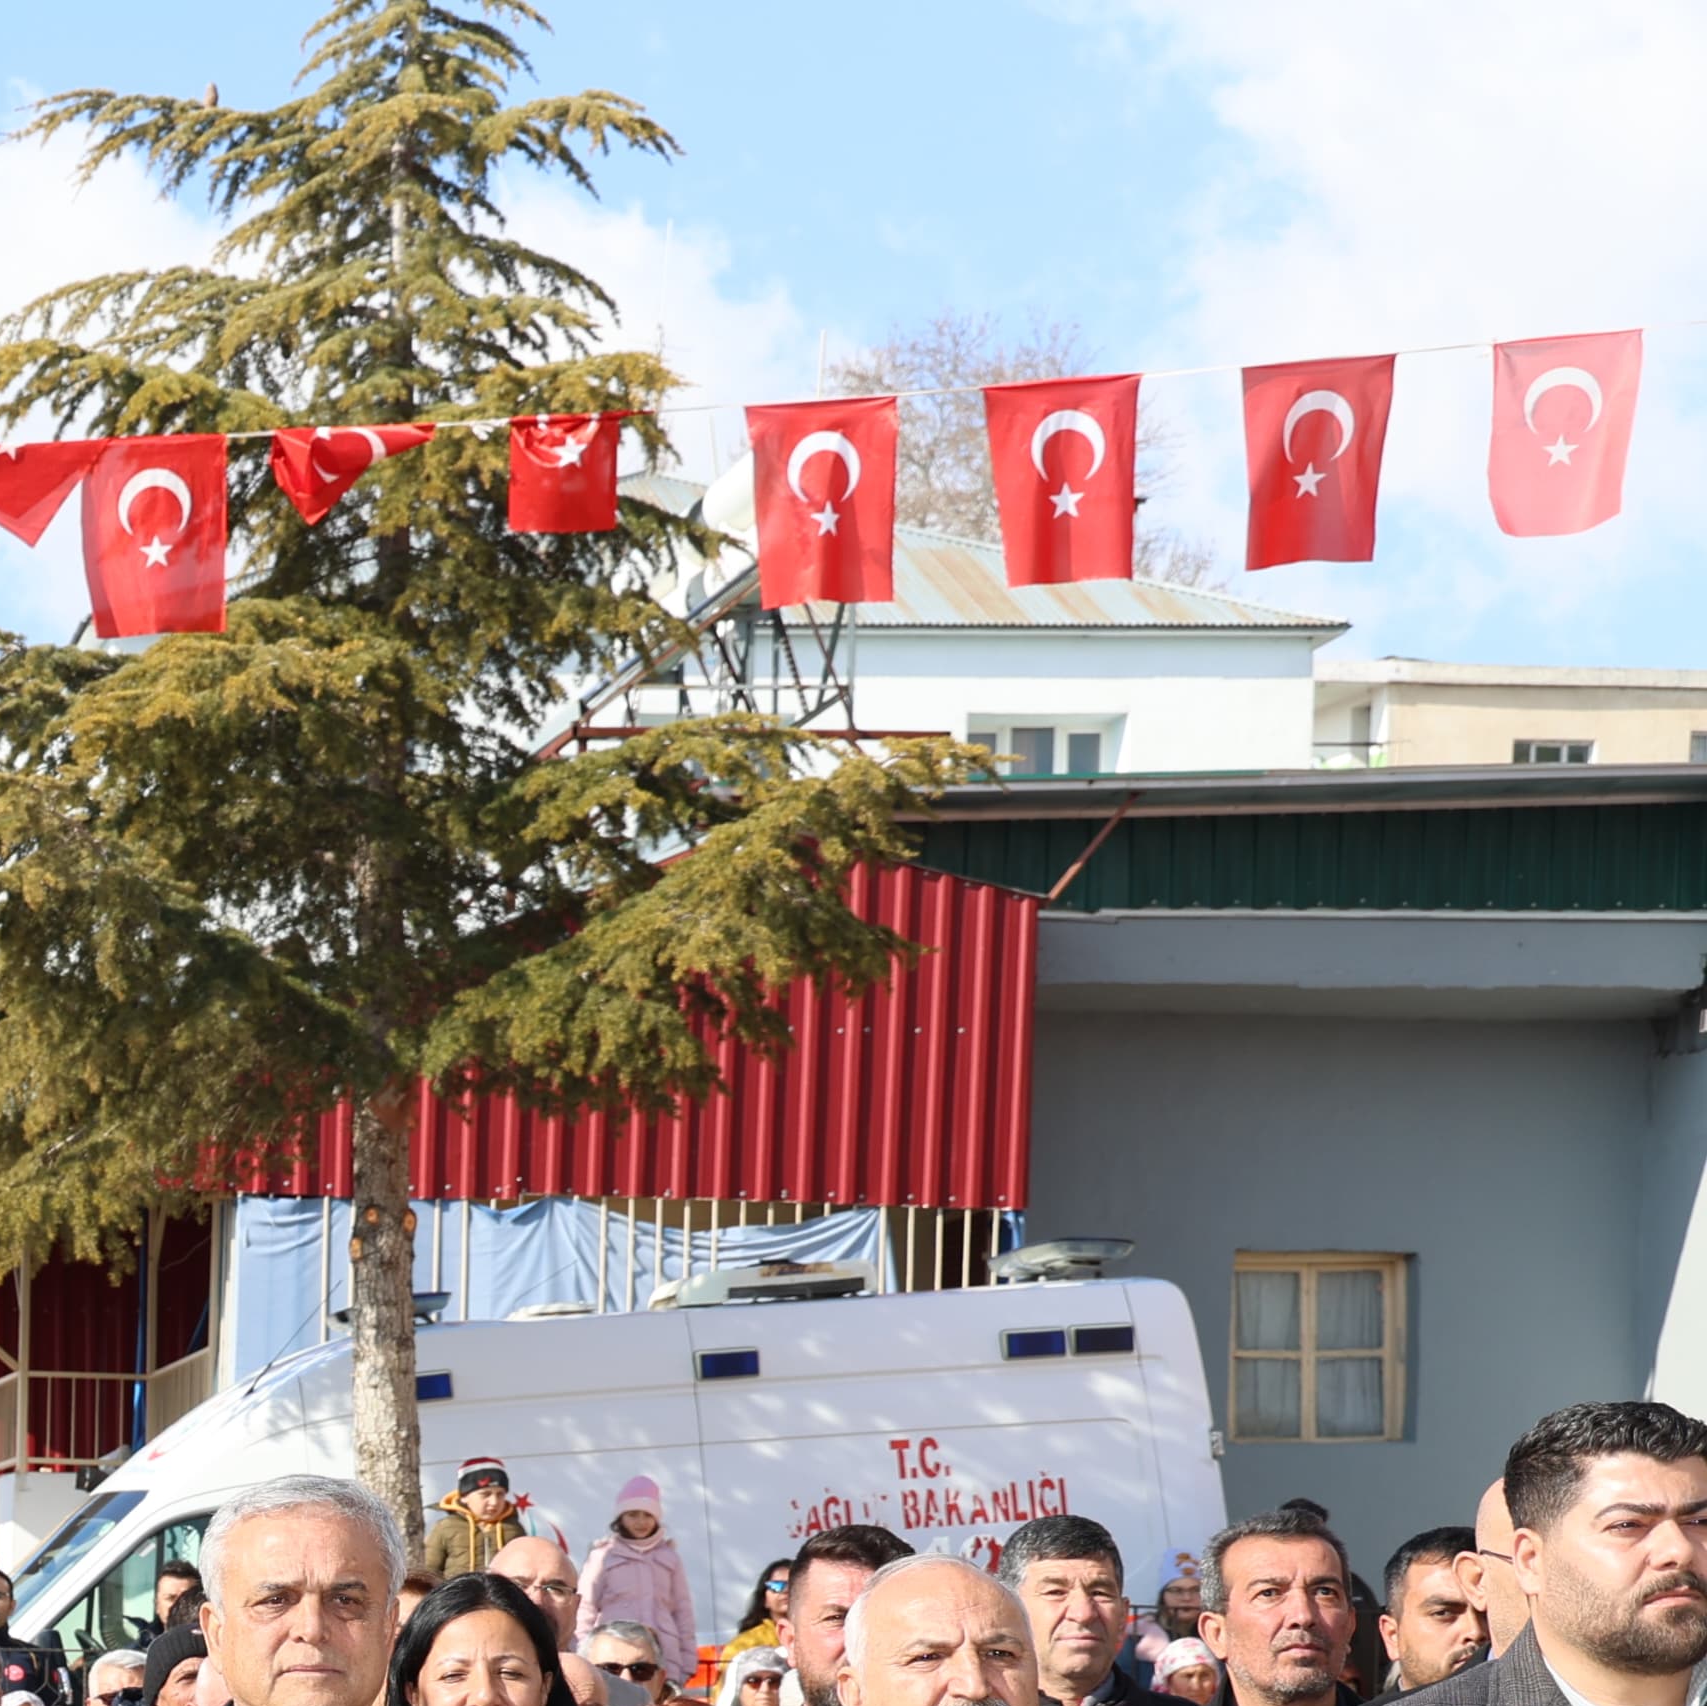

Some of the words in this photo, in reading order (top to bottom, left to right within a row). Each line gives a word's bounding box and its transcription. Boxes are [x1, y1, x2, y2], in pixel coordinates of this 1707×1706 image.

[889, 1437, 951, 1479] T.C.
[786, 1487, 890, 1538] AĞLI
[901, 1470, 1068, 1529] BAKANLIĞI
